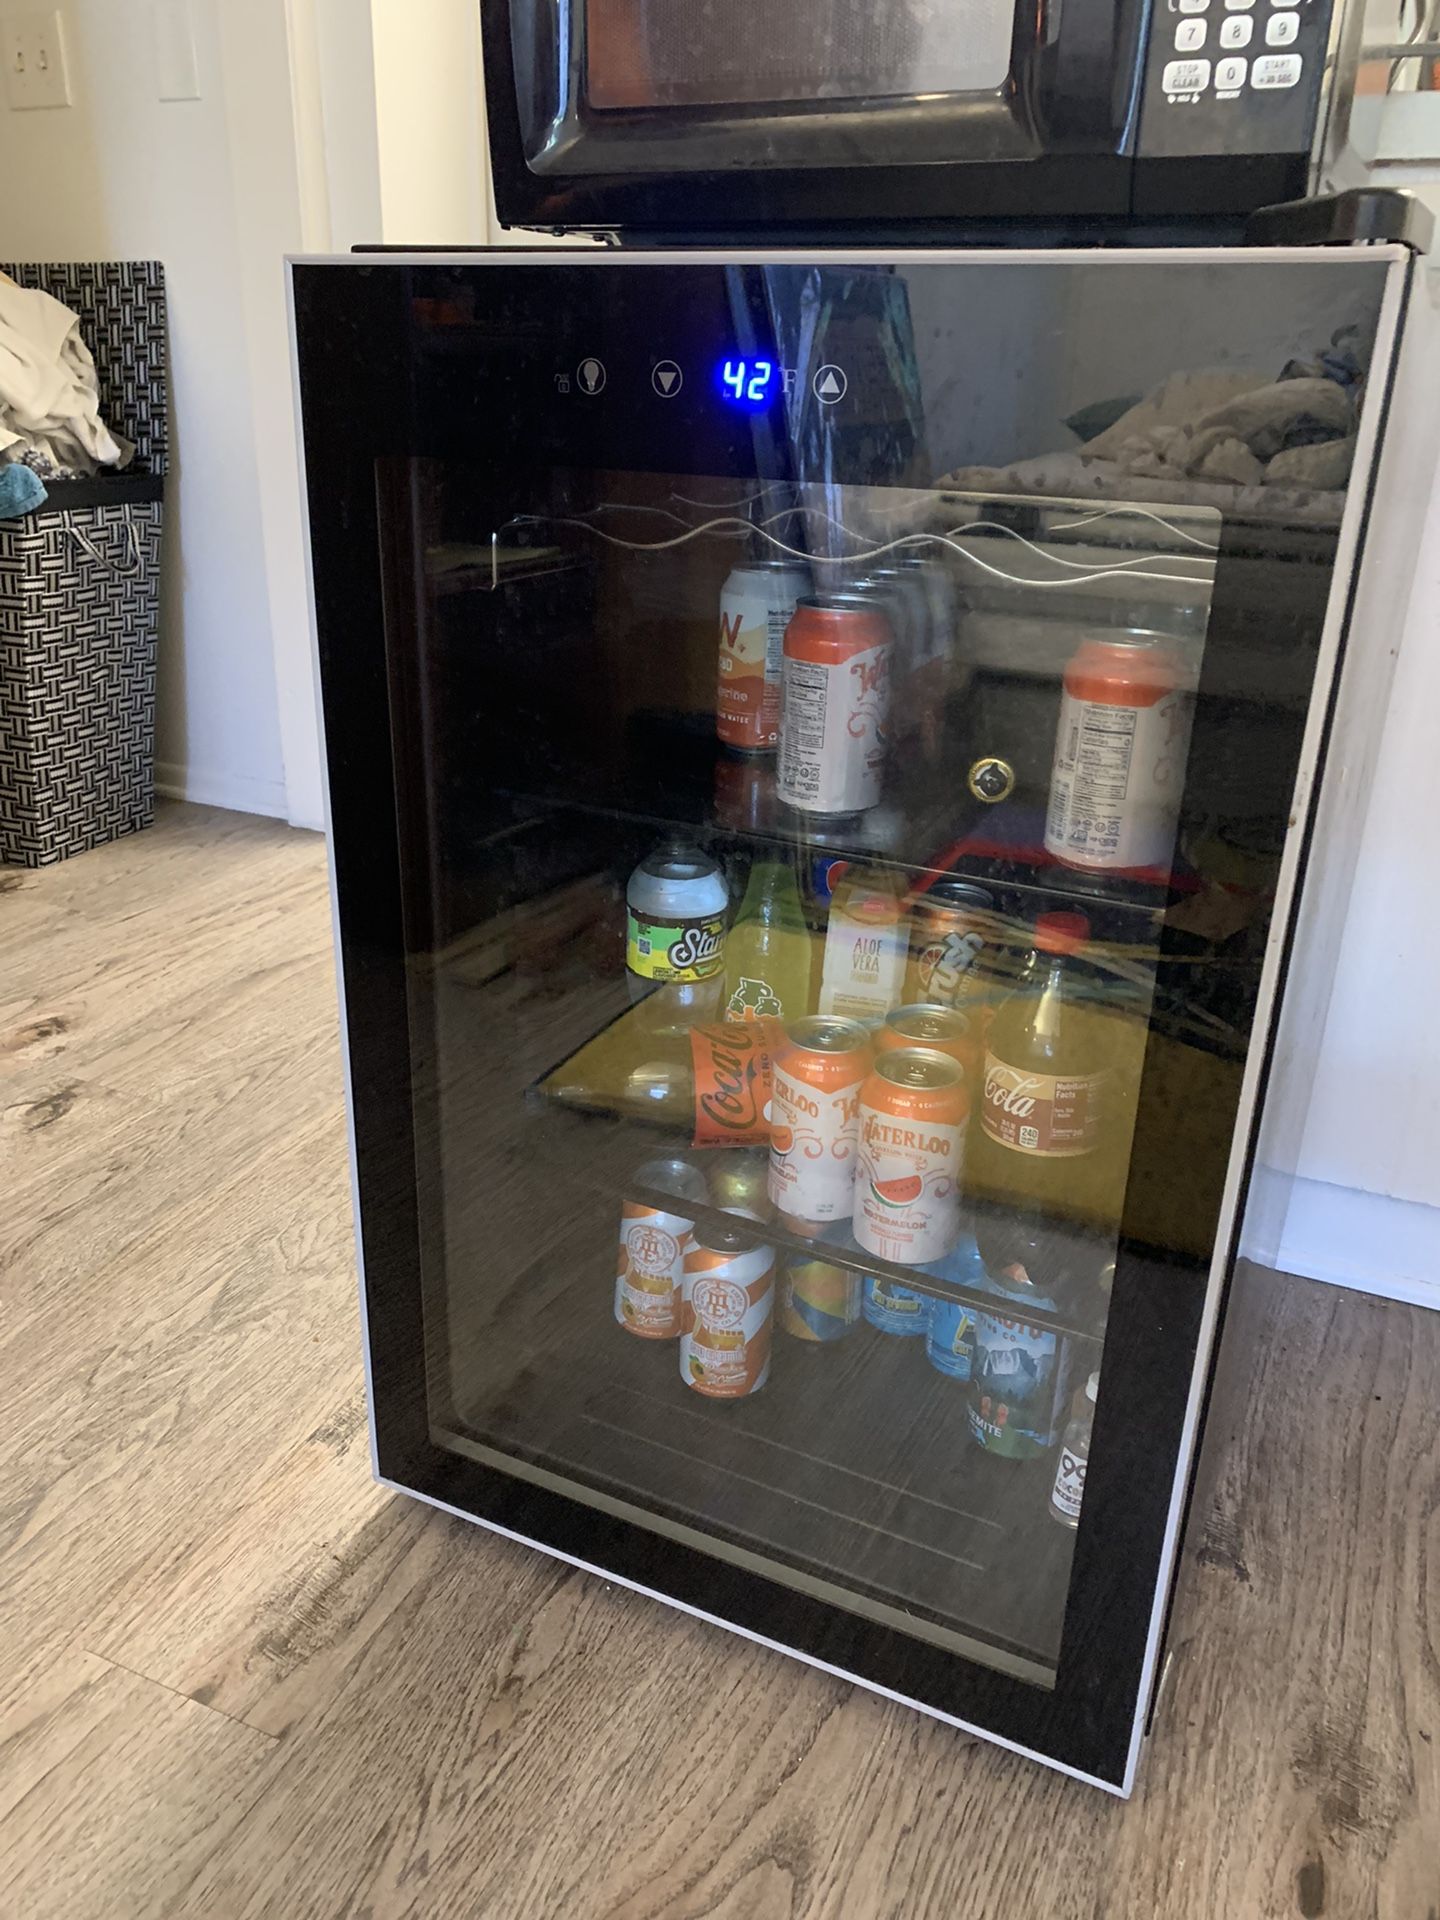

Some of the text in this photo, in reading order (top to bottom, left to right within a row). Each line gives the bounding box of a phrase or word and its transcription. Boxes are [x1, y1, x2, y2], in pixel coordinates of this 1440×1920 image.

[1187, 21, 1288, 41] 7 8 9
[1226, 66, 1236, 81] 0
[723, 361, 771, 400] 42
[854, 937, 882, 957] ALOE
[852, 953, 880, 973] VERA
[863, 1115, 951, 1157] WATERLOO
[863, 1205, 928, 1230] WATERMELON
